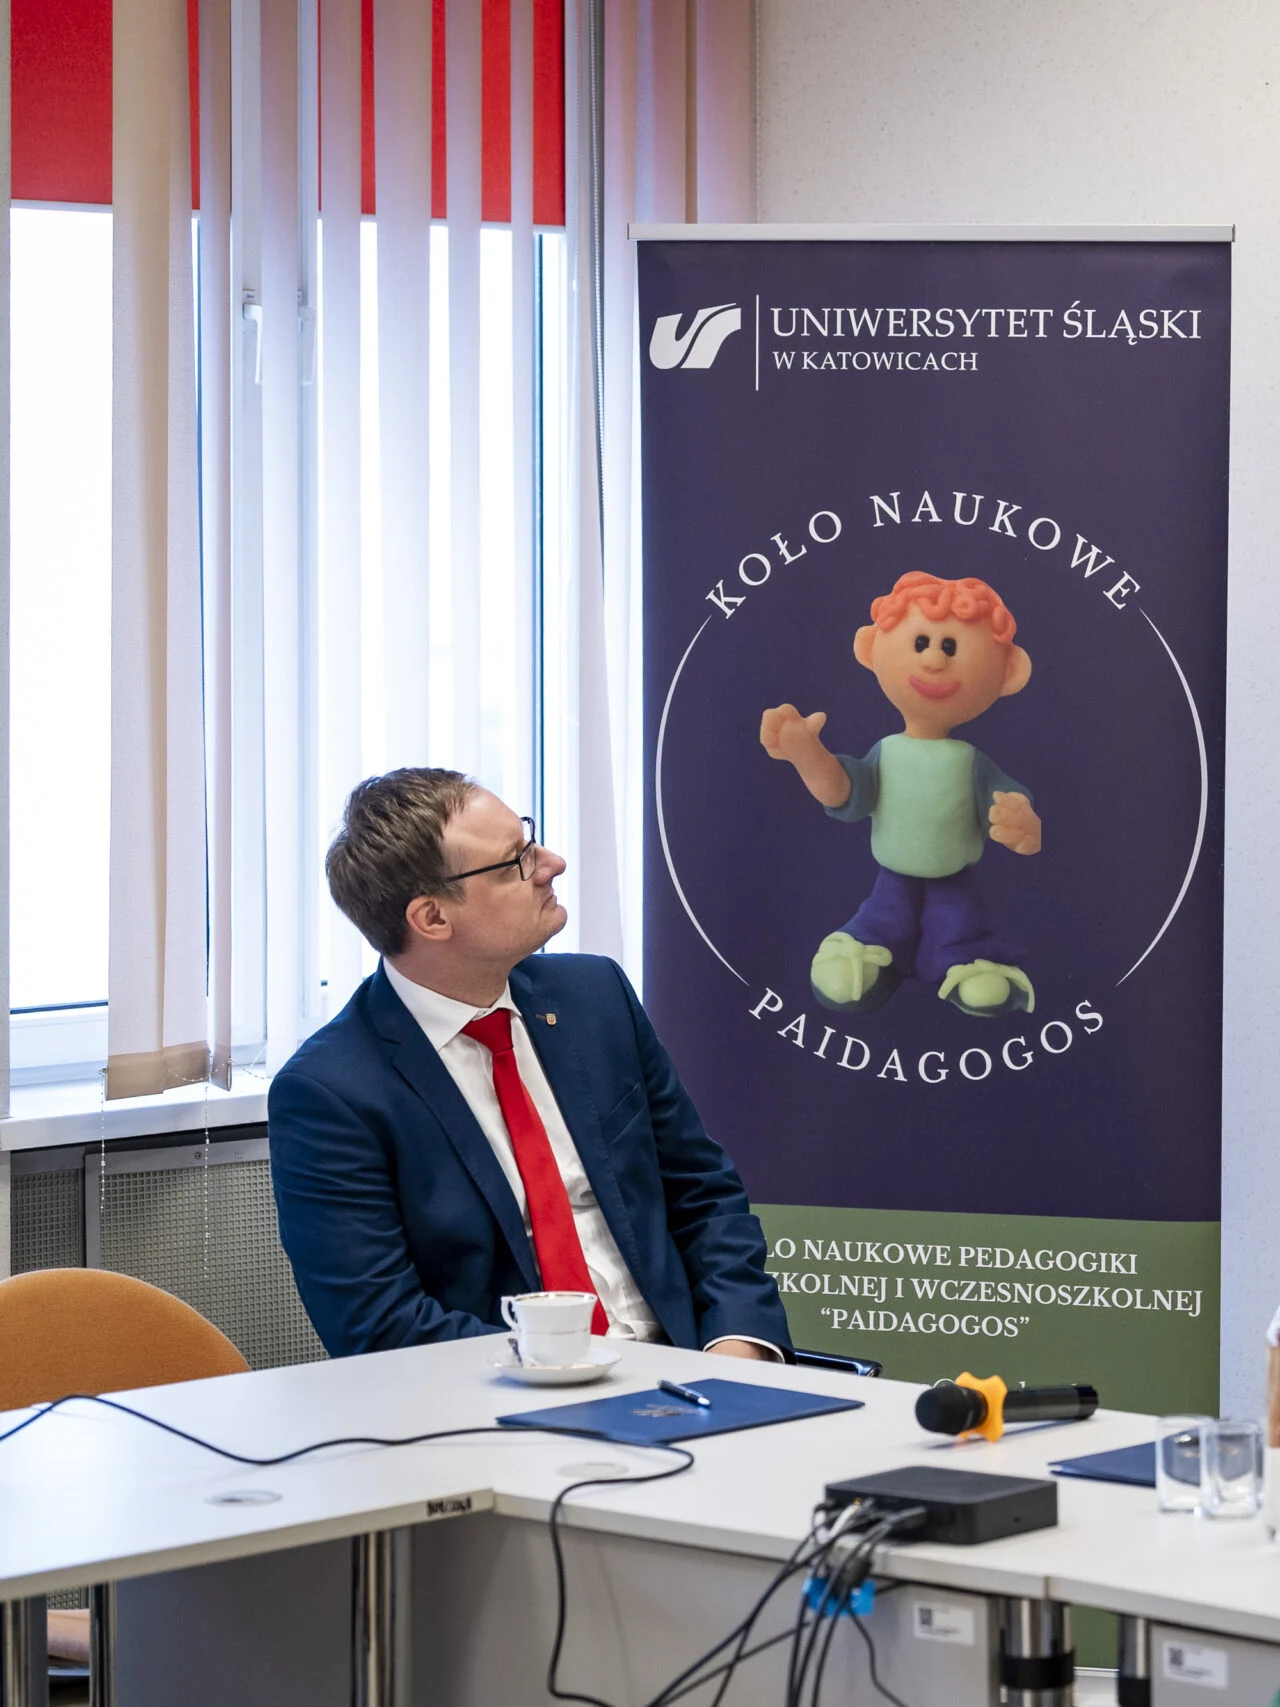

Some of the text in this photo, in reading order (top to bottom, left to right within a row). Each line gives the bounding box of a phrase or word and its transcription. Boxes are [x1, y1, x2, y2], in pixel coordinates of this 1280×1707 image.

[770, 307, 1054, 338] UNIWERSYTET
[1062, 300, 1202, 346] ŚLĄSKI
[772, 351, 979, 371] W KATOWICACH
[705, 490, 1141, 620] KOŁO NAUKOWE
[748, 986, 1104, 1084] PAIDAGOGOS
[802, 1239, 951, 1266] NAUKOWE
[958, 1246, 1138, 1275] PEDAGOGIKI
[894, 1277, 905, 1298] I
[909, 1278, 1204, 1318] WCZESNOSZKOLNEJ
[820, 1307, 1030, 1338] “PAIDAGOGOS”
